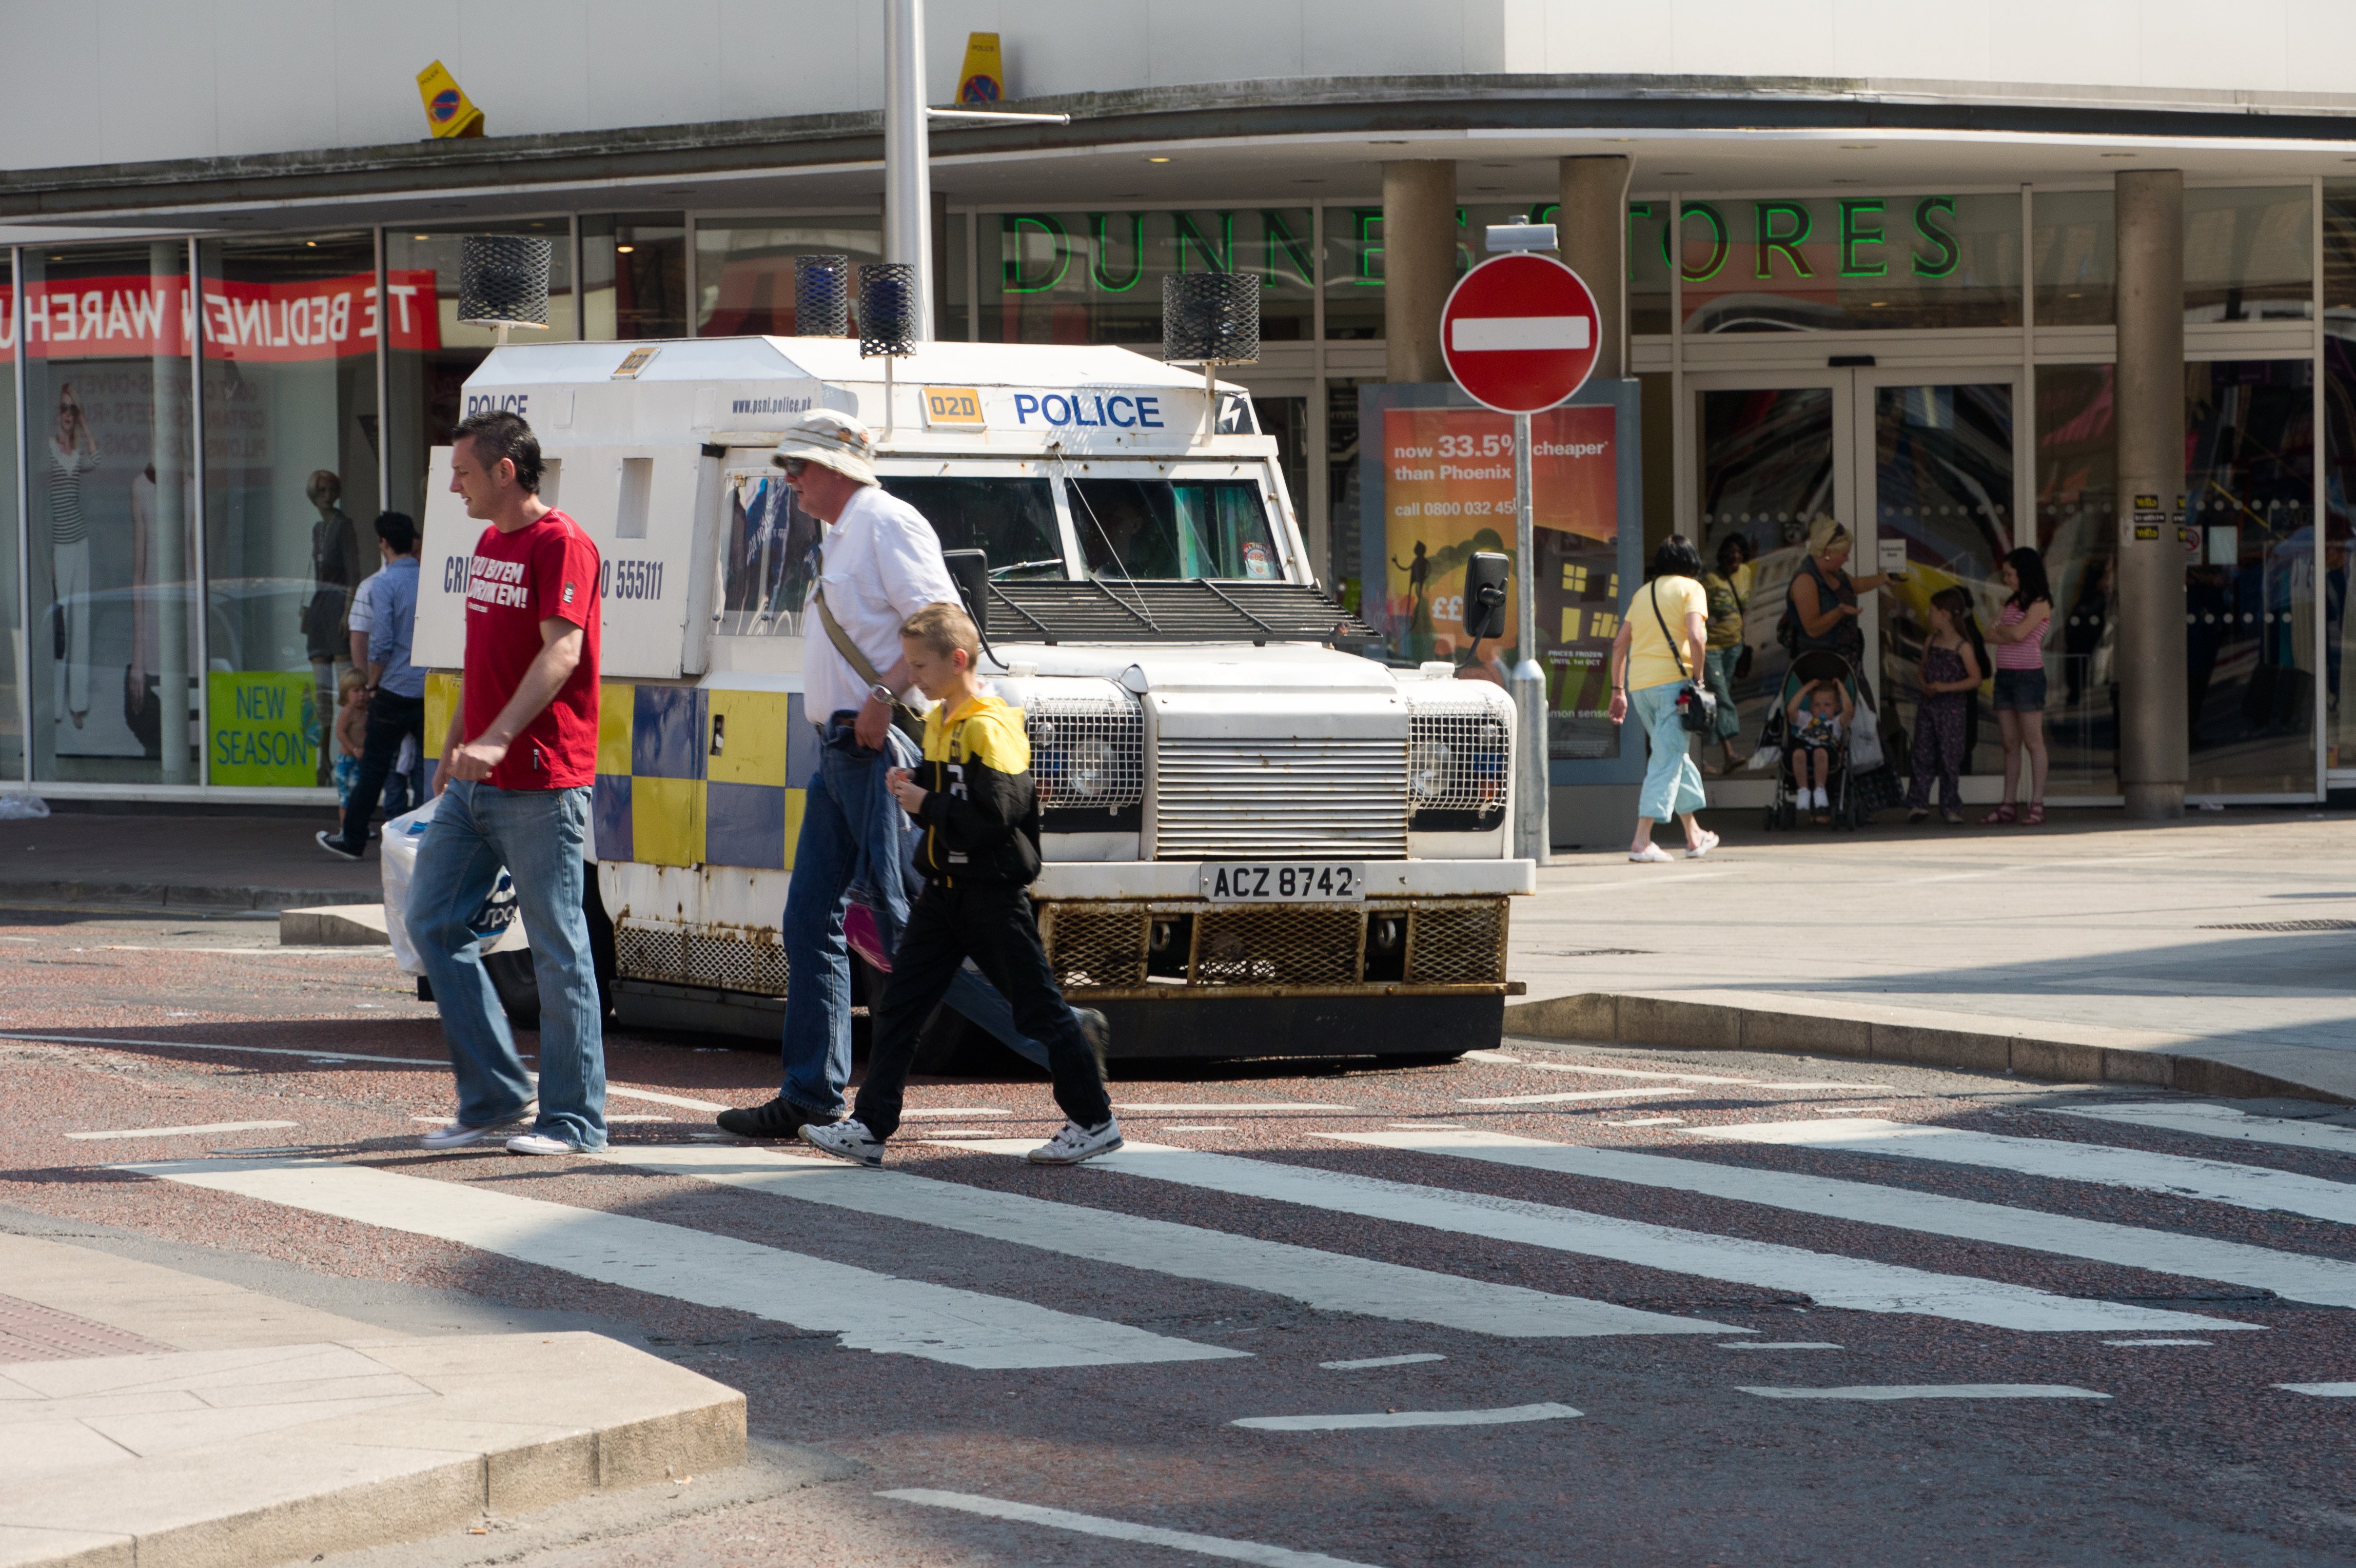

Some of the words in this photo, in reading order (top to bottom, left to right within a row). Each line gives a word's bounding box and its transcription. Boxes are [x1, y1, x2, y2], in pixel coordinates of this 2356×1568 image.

[1002, 206, 1471, 293] DUNNE
[1529, 196, 1961, 282] ORES
[733, 397, 812, 414] www.psni.police.uk
[1013, 393, 1165, 428] POLICE
[1395, 445, 1434, 459] now
[1395, 466, 1435, 481] than
[1440, 464, 1511, 481] Phoenix
[1395, 502, 1421, 517] call
[1424, 502, 1461, 516] 0800
[1464, 501, 1491, 515] 032
[1244, 543, 1269, 554] WARNING
[444, 556, 473, 593] CRI
[616, 560, 664, 600] 555111
[1575, 650, 1603, 658] FROZEN
[235, 685, 286, 720] NEW
[217, 729, 307, 767] SEASON
[1214, 867, 1270, 897] ACZ
[1279, 867, 1353, 897] 8742
